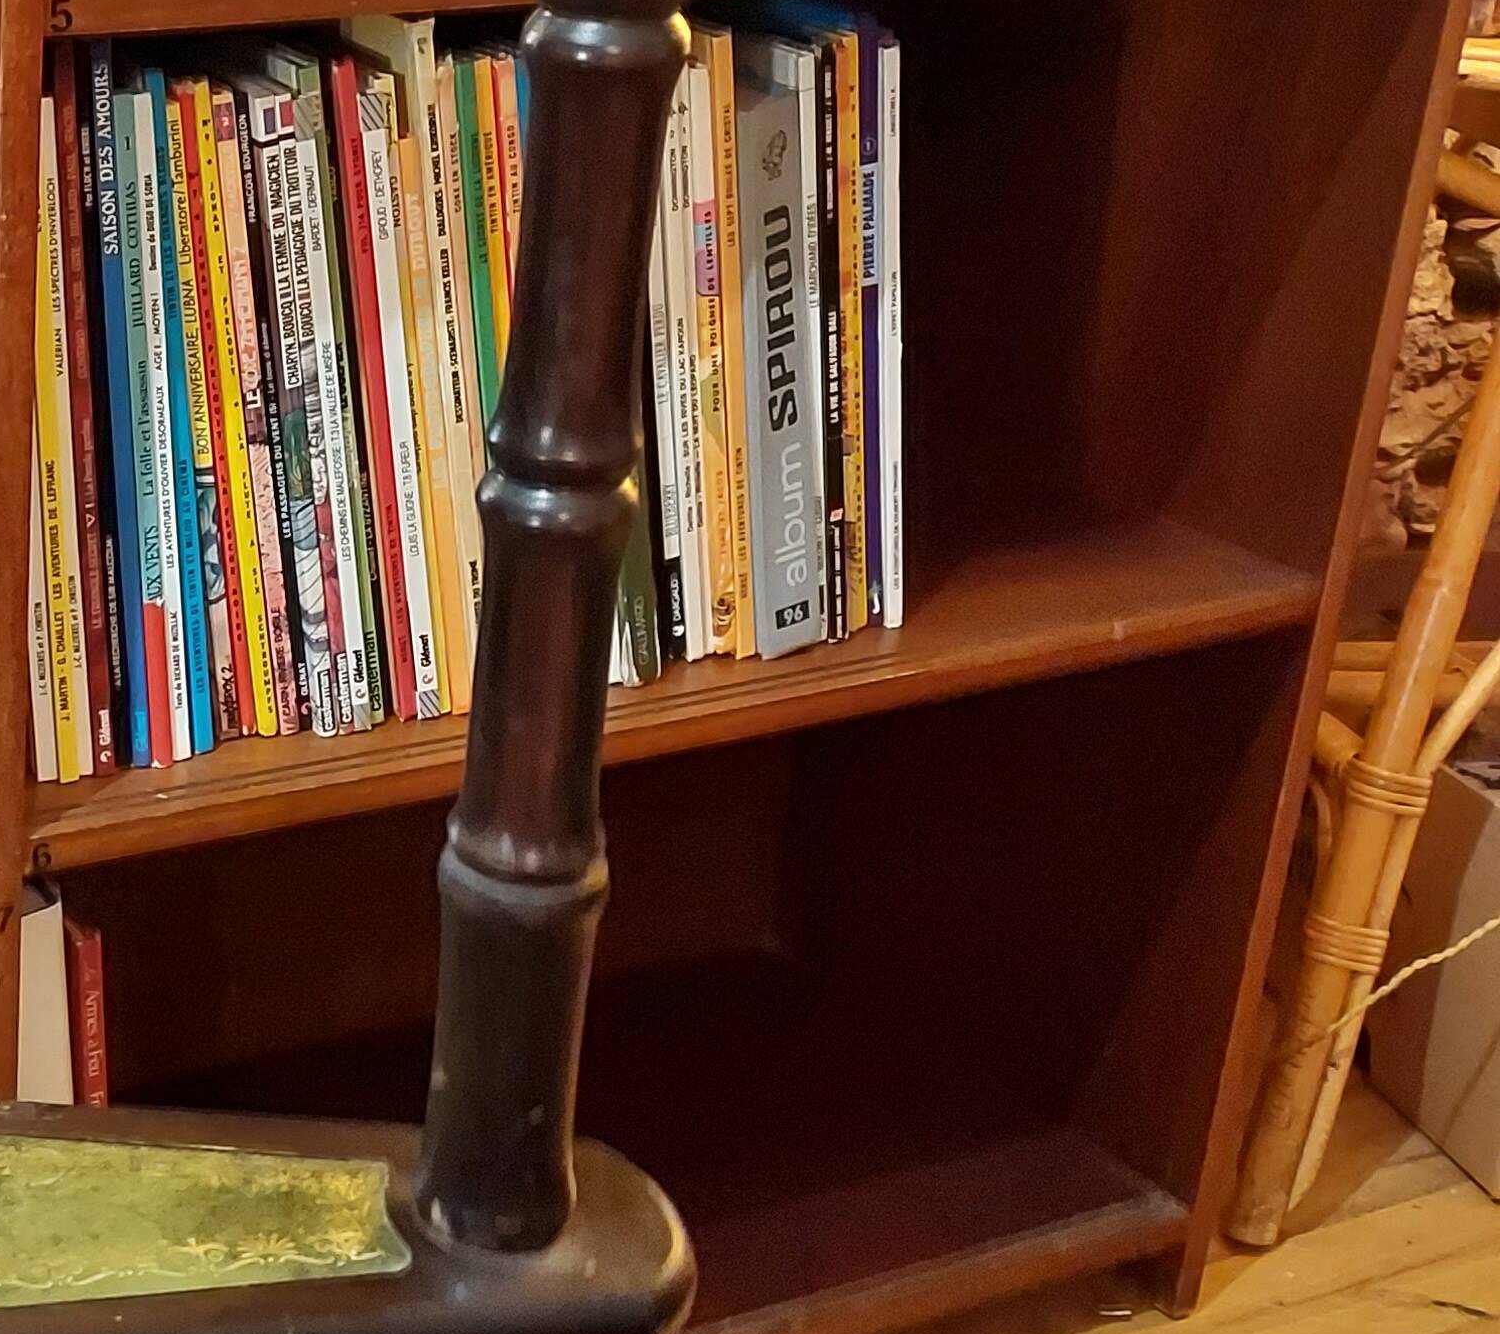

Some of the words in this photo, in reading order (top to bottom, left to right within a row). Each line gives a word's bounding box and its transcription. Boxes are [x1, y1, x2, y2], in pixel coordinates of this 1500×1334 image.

[93, 63, 113, 140] AMOURS
[722, 102, 733, 143] CRISTAL
[239, 114, 253, 171] BOURGEON
[483, 130, 495, 181] AMÉRIQUE
[507, 125, 517, 160] CONGO
[722, 146, 733, 160] DE
[98, 146, 114, 182] DES
[282, 145, 300, 197] TROTTOIR
[510, 163, 519, 178] AU
[265, 154, 282, 209] MAGICIEN
[488, 184, 497, 198] EN
[512, 182, 521, 214] TINTIN
[46, 177, 58, 245] D'INVERLOCH
[124, 181, 139, 249] COTHIAS
[288, 199, 303, 215] DU
[390, 176, 402, 228] GASTON
[861, 170, 875, 230] PALMADE
[100, 190, 120, 255] SAISON
[271, 212, 285, 227] DU
[309, 216, 322, 252] BARDET
[375, 206, 389, 240] GIROUD
[407, 192, 427, 271] DUBOUT
[490, 202, 499, 234] TINTIN
[805, 203, 816, 238] D'IDÉES
[273, 230, 289, 271] FEMME
[290, 218, 309, 276] PEDAGOGIE
[703, 210, 714, 270] LENTILLES
[862, 233, 875, 279] PIERRE
[49, 247, 60, 293] SPECTRES
[440, 249, 451, 278] KELLER
[807, 241, 818, 296] MARCHAND
[129, 258, 146, 329] JUILLARD
[278, 275, 293, 291] LA
[297, 277, 310, 291] LA
[706, 277, 715, 291] DE
[52, 296, 61, 313] LES
[151, 299, 162, 335] MOYEN
[181, 278, 197, 324] LUBNA
[299, 302, 314, 338] BOUCQ
[707, 298, 717, 348] POIGNEE
[763, 205, 798, 432] SPIROU
[828, 311, 837, 333] DALI
[208, 180, 219, 232] JOHAN
[217, 255, 225, 274] ET
[221, 296, 236, 376] PIRLOUIT
[237, 433, 244, 451] LA
[241, 472, 252, 519] FLUTE
[676, 317, 686, 355] KAROUN
[153, 351, 163, 371] AGE
[654, 341, 669, 389] CAVALIER
[677, 358, 686, 376] LAC
[710, 354, 719, 376] UNE
[828, 334, 839, 379] SALVADOR
[184, 327, 207, 423] ANNIVERSAIRE,
[324, 373, 334, 387] DE
[678, 378, 687, 391] DU
[829, 381, 838, 393] DE
[136, 360, 150, 425] l'assassin
[246, 388, 261, 409] LE
[325, 388, 339, 417] VALLÉE
[657, 390, 670, 404] LE
[692, 398, 699, 412] DU
[711, 389, 720, 412] POUR
[829, 395, 839, 409] VIE
[155, 386, 168, 450] DESORMEAUX
[270, 417, 281, 443] VENT
[329, 418, 339, 429] LA
[680, 421, 689, 437] LES
[829, 410, 839, 424] LA
[139, 429, 150, 443] et
[194, 424, 210, 455] BON
[273, 445, 284, 460] DU
[682, 439, 691, 458] SUR
[139, 446, 153, 478] folle
[159, 452, 171, 497] D'OLIVIER
[734, 447, 744, 475] TINTIN
[44, 459, 56, 503] LEFRANC
[142, 480, 155, 497] La
[275, 461, 290, 519] PASSAGERS
[734, 478, 744, 491] DE
[47, 506, 57, 520] DE
[335, 498, 346, 512] DE
[735, 493, 747, 542] AVENTURES
[774, 443, 808, 587] album
[161, 499, 174, 551] AVENTURES
[281, 521, 292, 538] LES
[405, 523, 416, 534] LA
[46, 524, 61, 578] AVENTURES
[144, 525, 161, 569] VENTS
[164, 553, 175, 569] LES
[340, 545, 352, 562] LES
[406, 536, 420, 556] LOUIS
[736, 545, 747, 562] LES
[52, 583, 63, 600] LES
[54, 611, 66, 651] CHAILLET
[776, 604, 807, 627] 96
[355, 649, 366, 683] Glénat
[420, 634, 432, 667] Glénat
[221, 666, 233, 674] 2
[364, 630, 382, 712] casterman
[58, 676, 69, 711] MARTIN
[335, 652, 353, 724] casterman
